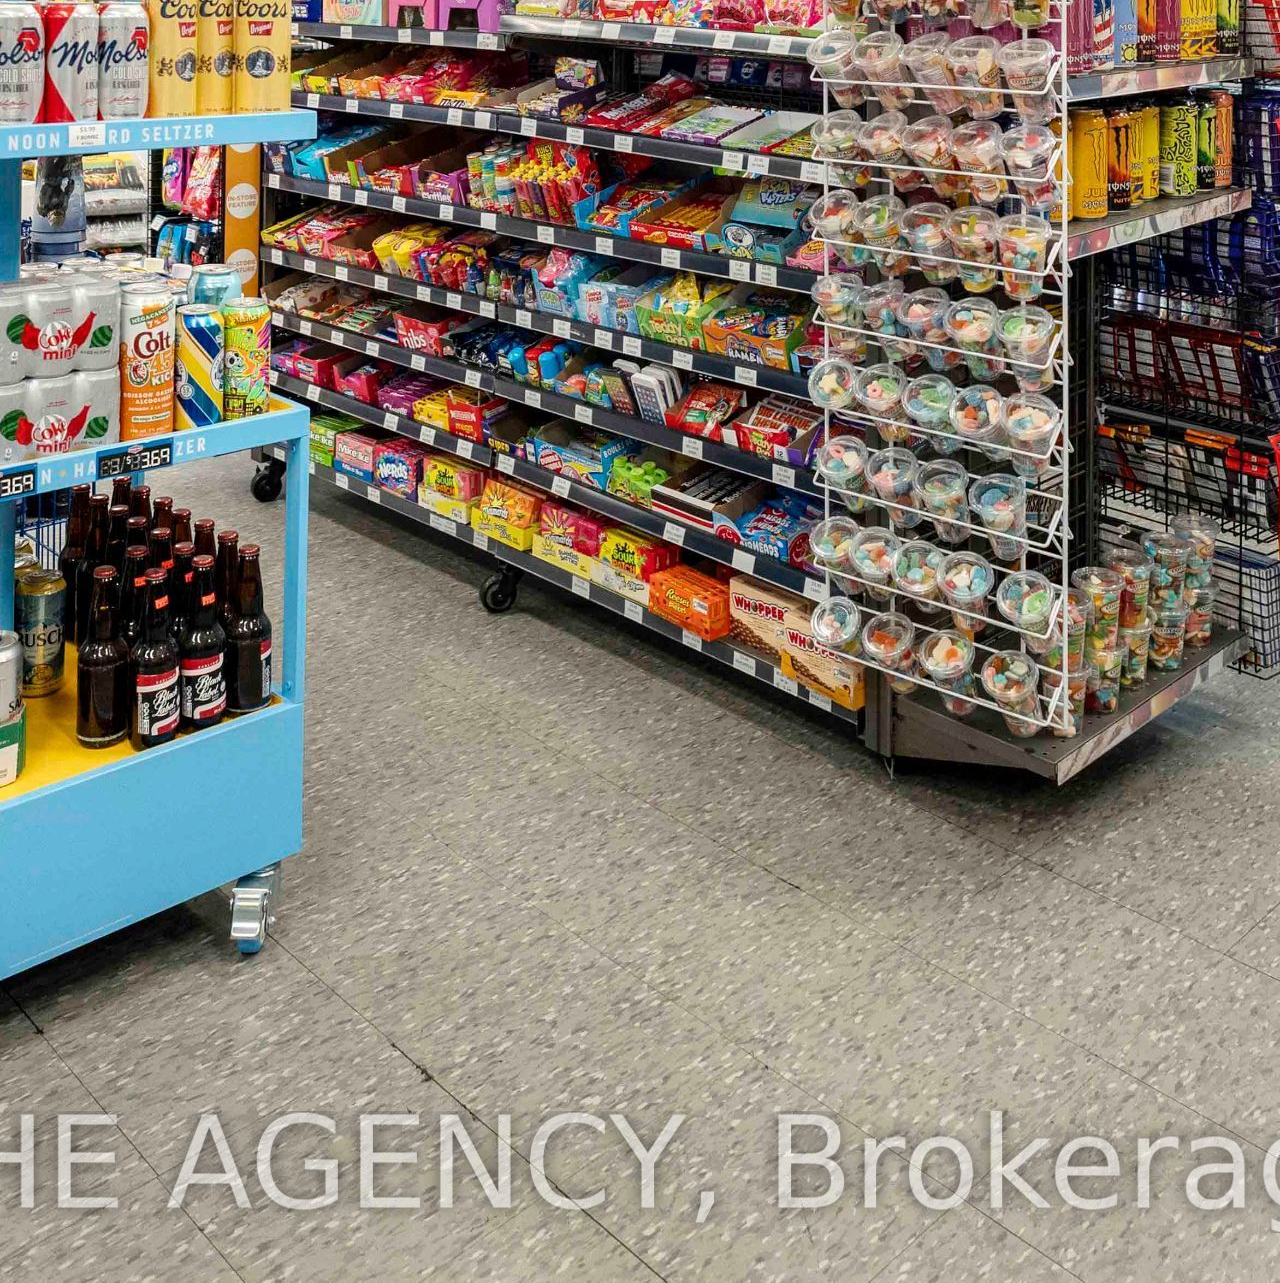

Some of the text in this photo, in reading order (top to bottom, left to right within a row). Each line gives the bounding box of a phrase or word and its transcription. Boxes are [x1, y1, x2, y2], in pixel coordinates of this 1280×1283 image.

[8, 132, 60, 151] NOON
[109, 129, 131, 145] RD
[142, 123, 215, 142] SELTZER
[39, 326, 73, 352] Coke
[133, 331, 171, 360] Colt
[401, 332, 427, 350] nibs
[42, 346, 77, 362] mini
[151, 372, 171, 386] KIC
[32, 420, 68, 444] Coke
[36, 438, 71, 455] mini
[613, 549, 635, 565] SOUR
[665, 589, 690, 608] Reese's
[195, 672, 222, 692] Black
[153, 684, 179, 706] Black
[195, 686, 221, 703] Label
[152, 698, 176, 718] Label
